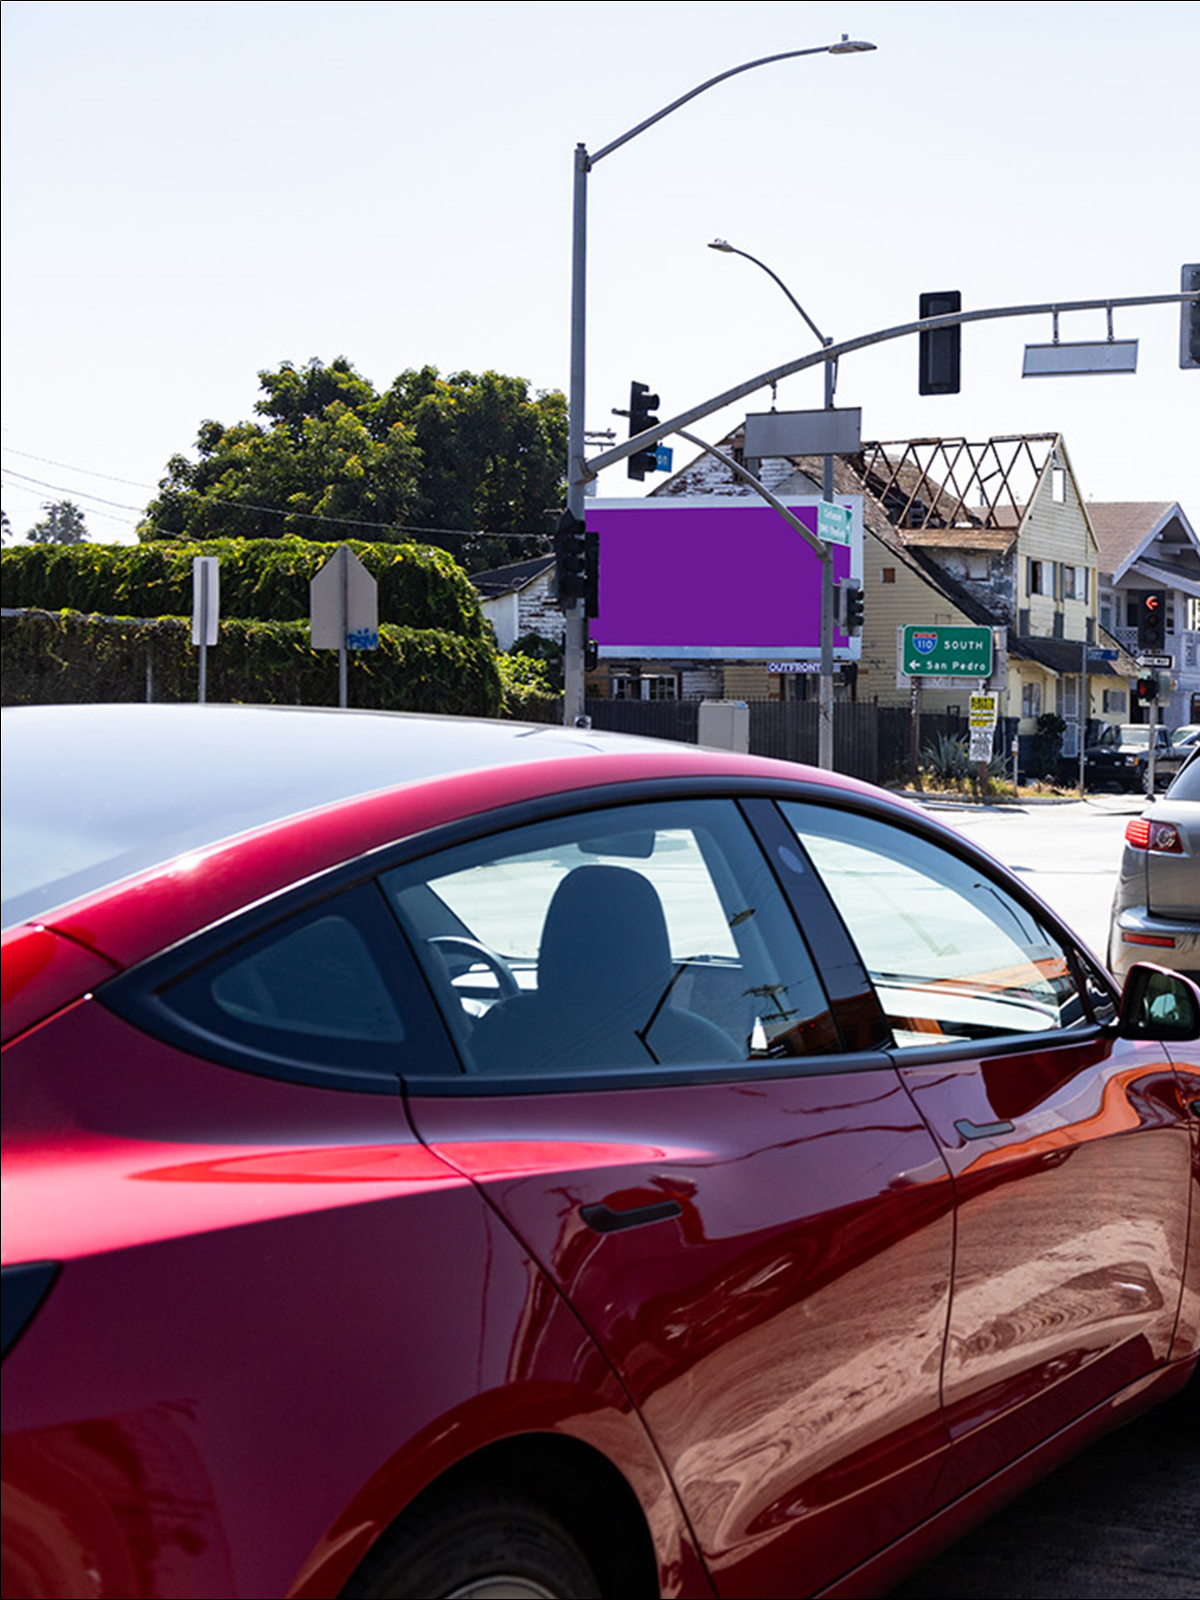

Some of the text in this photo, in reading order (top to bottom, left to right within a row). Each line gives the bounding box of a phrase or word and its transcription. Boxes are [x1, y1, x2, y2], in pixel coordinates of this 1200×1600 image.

[917, 640, 983, 650] 110 SOUTH
[768, 662, 822, 672] OUTFRONT
[926, 660, 986, 671] San Pedro
